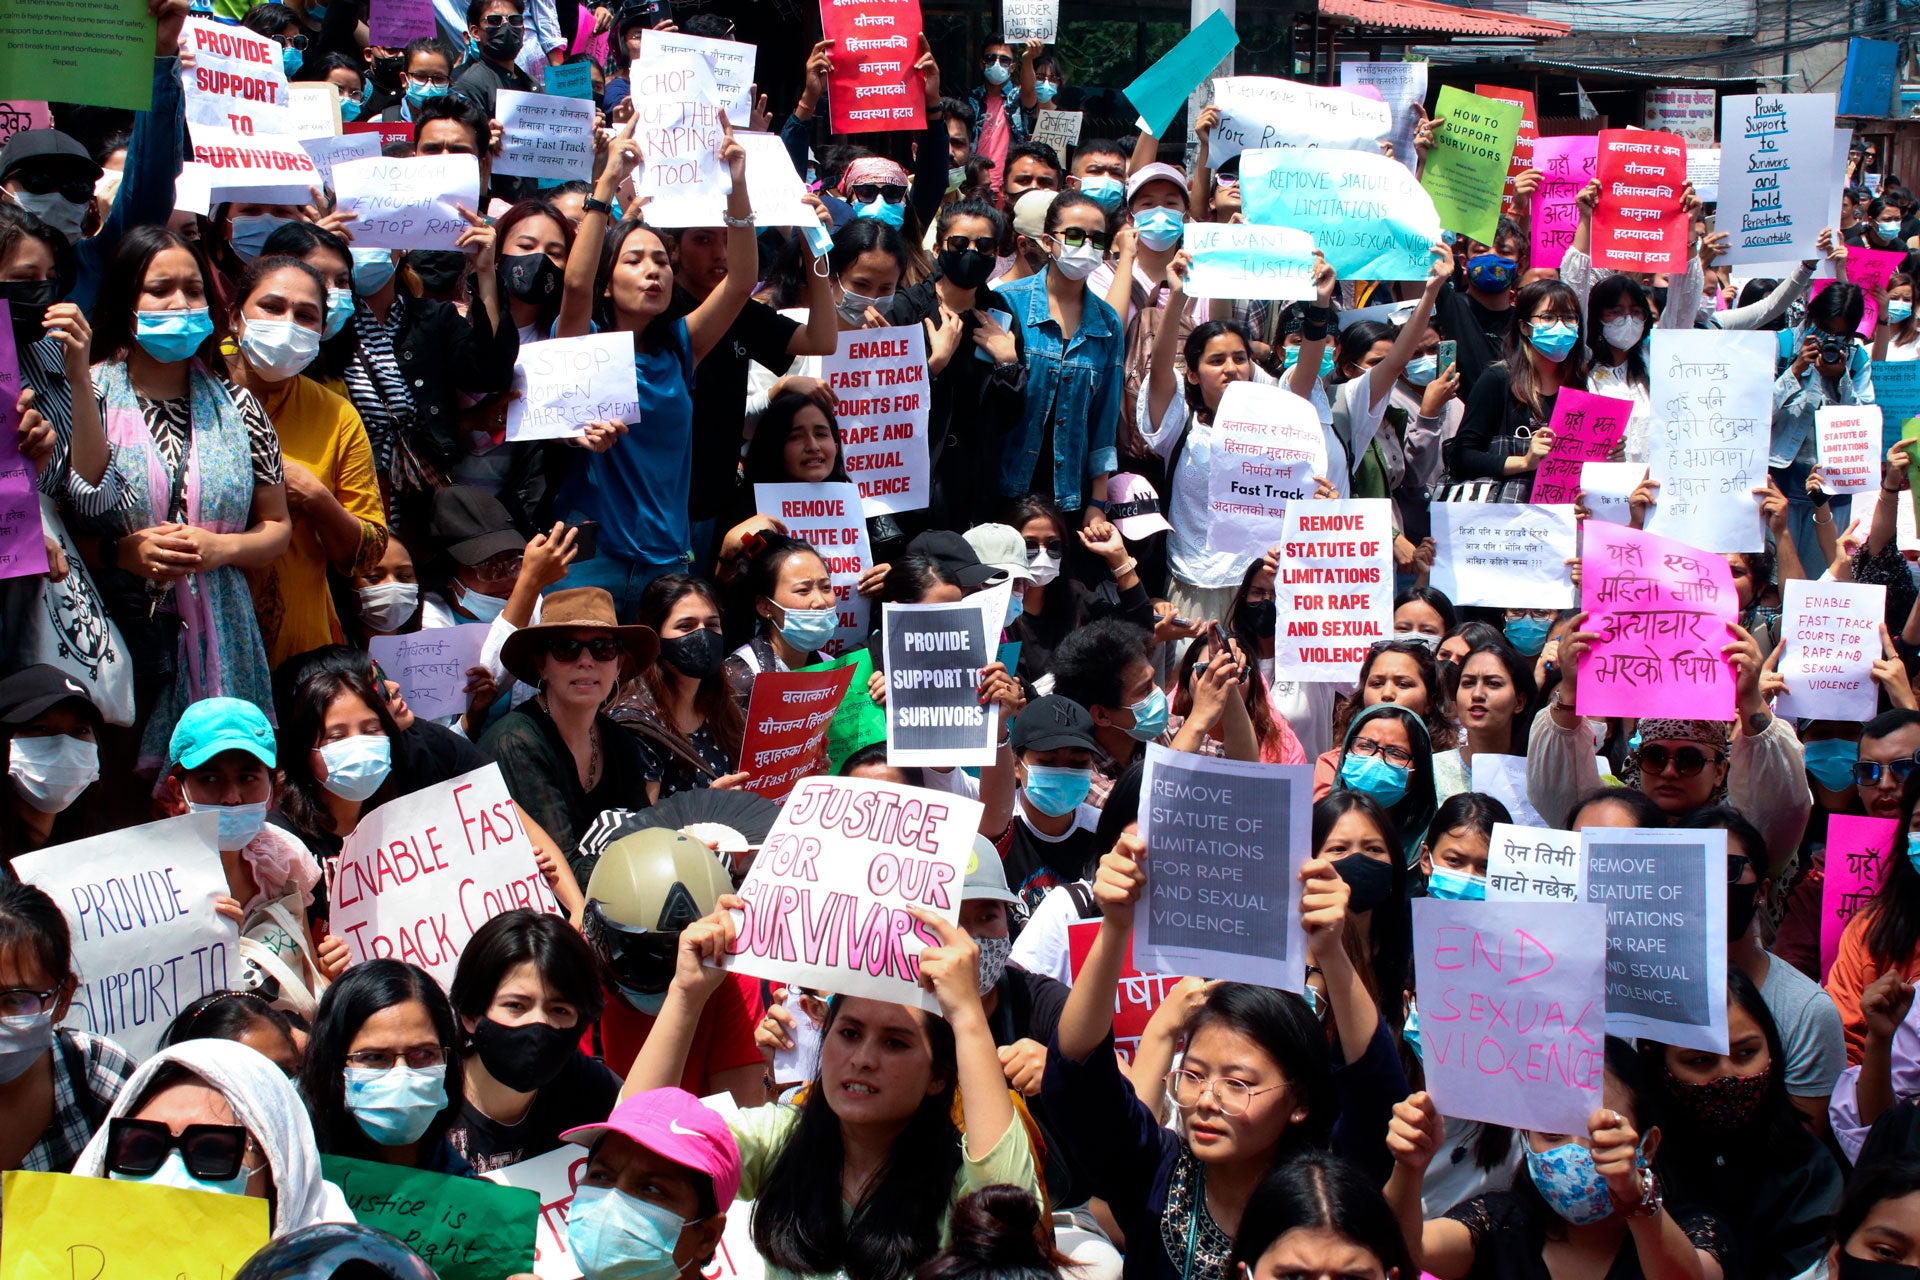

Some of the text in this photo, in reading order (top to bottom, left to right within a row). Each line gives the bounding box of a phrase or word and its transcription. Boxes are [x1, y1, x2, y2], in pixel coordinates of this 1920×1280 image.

[1007, 4, 1051, 16] ABUSER
[854, 13, 894, 26] यौनजन्य
[1008, 28, 1049, 39] ABUSED
[45, 43, 59, 51] trust
[61, 44, 75, 52] and
[194, 28, 272, 64] PROVIDE
[859, 62, 900, 76] कानुनमा
[196, 68, 278, 104] SUPPORT
[640, 70, 696, 96] CHOP
[856, 81, 906, 98] हदम्यादको
[849, 107, 914, 120] व्यवस्था हटाउ
[1755, 96, 1784, 113] Provide
[228, 114, 254, 136] TO
[1454, 108, 1498, 128] HOW TO
[1745, 116, 1786, 134] Support
[1446, 122, 1498, 144] SUPPORT
[536, 138, 586, 152] Fast Track
[646, 127, 716, 161] RAPING
[1440, 136, 1500, 162] SURVIVORS
[1608, 142, 1680, 157] बलात्कार र अन्य
[1760, 136, 1775, 149] to
[194, 145, 314, 172] SURVIVORS
[1749, 154, 1788, 170] Survivors
[651, 160, 703, 186] TOOL
[1624, 161, 1665, 176] यौनजन्य
[1268, 170, 1330, 190] REMOVE
[1756, 173, 1777, 188] and
[352, 196, 432, 210] ENOUGH
[1752, 191, 1780, 208] hold
[1294, 199, 1387, 219] LIMITATIONS
[1620, 207, 1661, 222] कानुनमा
[358, 218, 469, 236] STOP RAPE
[1614, 228, 1664, 241] हदम्यादको
[1193, 232, 1220, 250] WE
[1319, 230, 1396, 250] AND SEXUAL
[1745, 232, 1791, 246] accountable
[1606, 250, 1671, 264] व्यवस्था हटाउ
[849, 340, 908, 360] ENABLE
[534, 347, 610, 376] STOP
[830, 365, 922, 389] FAST TRACK
[832, 394, 919, 416] COURTS FOR
[1830, 419, 1860, 428] REMOVE
[839, 423, 914, 445] RAPE AND
[1824, 430, 1868, 440] STATUTE OF
[1824, 442, 1868, 452] LIMITATIONS
[846, 452, 903, 472] SEXUAL
[1828, 454, 1864, 464] FOR RAPE
[1242, 462, 1291, 479] निर्णय गर्न
[1826, 466, 1871, 476] AND SEXUAL
[1231, 481, 1304, 500] Fast Track
[1832, 478, 1866, 486] VIOLENCE
[1212, 501, 1264, 516] अदालतको
[1300, 515, 1364, 532] REMOVE
[1286, 541, 1380, 558] STATUTE OF
[1283, 568, 1380, 584] LIMITATIONS
[1597, 570, 1660, 602] महिला
[1294, 594, 1370, 610] FOR RAPE
[1805, 596, 1852, 608] ENABLE
[1288, 621, 1382, 636] AND SEXUAL
[1601, 610, 1717, 643] अत्याचार
[1798, 615, 1874, 630] FAST TRACK
[904, 630, 970, 652] PROVIDE
[1798, 630, 1860, 645] COURTS FOR
[1802, 646, 1862, 662] RAPE AND
[1802, 664, 1844, 674] SEXUAL
[894, 668, 985, 690] SUPPORT TO
[1808, 680, 1860, 690] VIOLENCE
[782, 687, 830, 704] बलात्कार
[899, 706, 984, 727] SURVIVORS
[759, 717, 804, 735] यौनजन्य
[762, 771, 788, 788] Fast
[1154, 780, 1232, 804] REMOVE
[454, 784, 528, 856] FAST
[790, 784, 949, 854] JUSTICE
[1152, 808, 1263, 833] STATUTE OF
[1152, 835, 1264, 860] LIMITATIONS
[1504, 840, 1576, 867] ऐन तिमी
[340, 826, 449, 909] ENABLE
[756, 833, 956, 910] FOR OUR
[1152, 860, 1243, 882] FOR RAPE
[1590, 858, 1656, 874] REMOVE
[1491, 872, 1529, 894] बाटो
[1154, 885, 1269, 911] AND SEXUAL
[1590, 885, 1683, 900] STATUTE OF
[72, 868, 189, 941] PROVIDE
[726, 878, 943, 982] SURVIVORS
[1153, 910, 1250, 936] VIOLENCE.
[344, 912, 459, 970] TRACK
[1627, 938, 1666, 953] RAPE
[1434, 927, 1555, 985] END
[190, 942, 228, 998] TO
[1631, 964, 1690, 981] SEXUAL
[1606, 983, 1678, 1006] VIOLENCE.
[1429, 988, 1596, 1046] SEXUAL
[1426, 1031, 1605, 1091] VIOLENCE
[343, 1170, 468, 1230] Justice is
